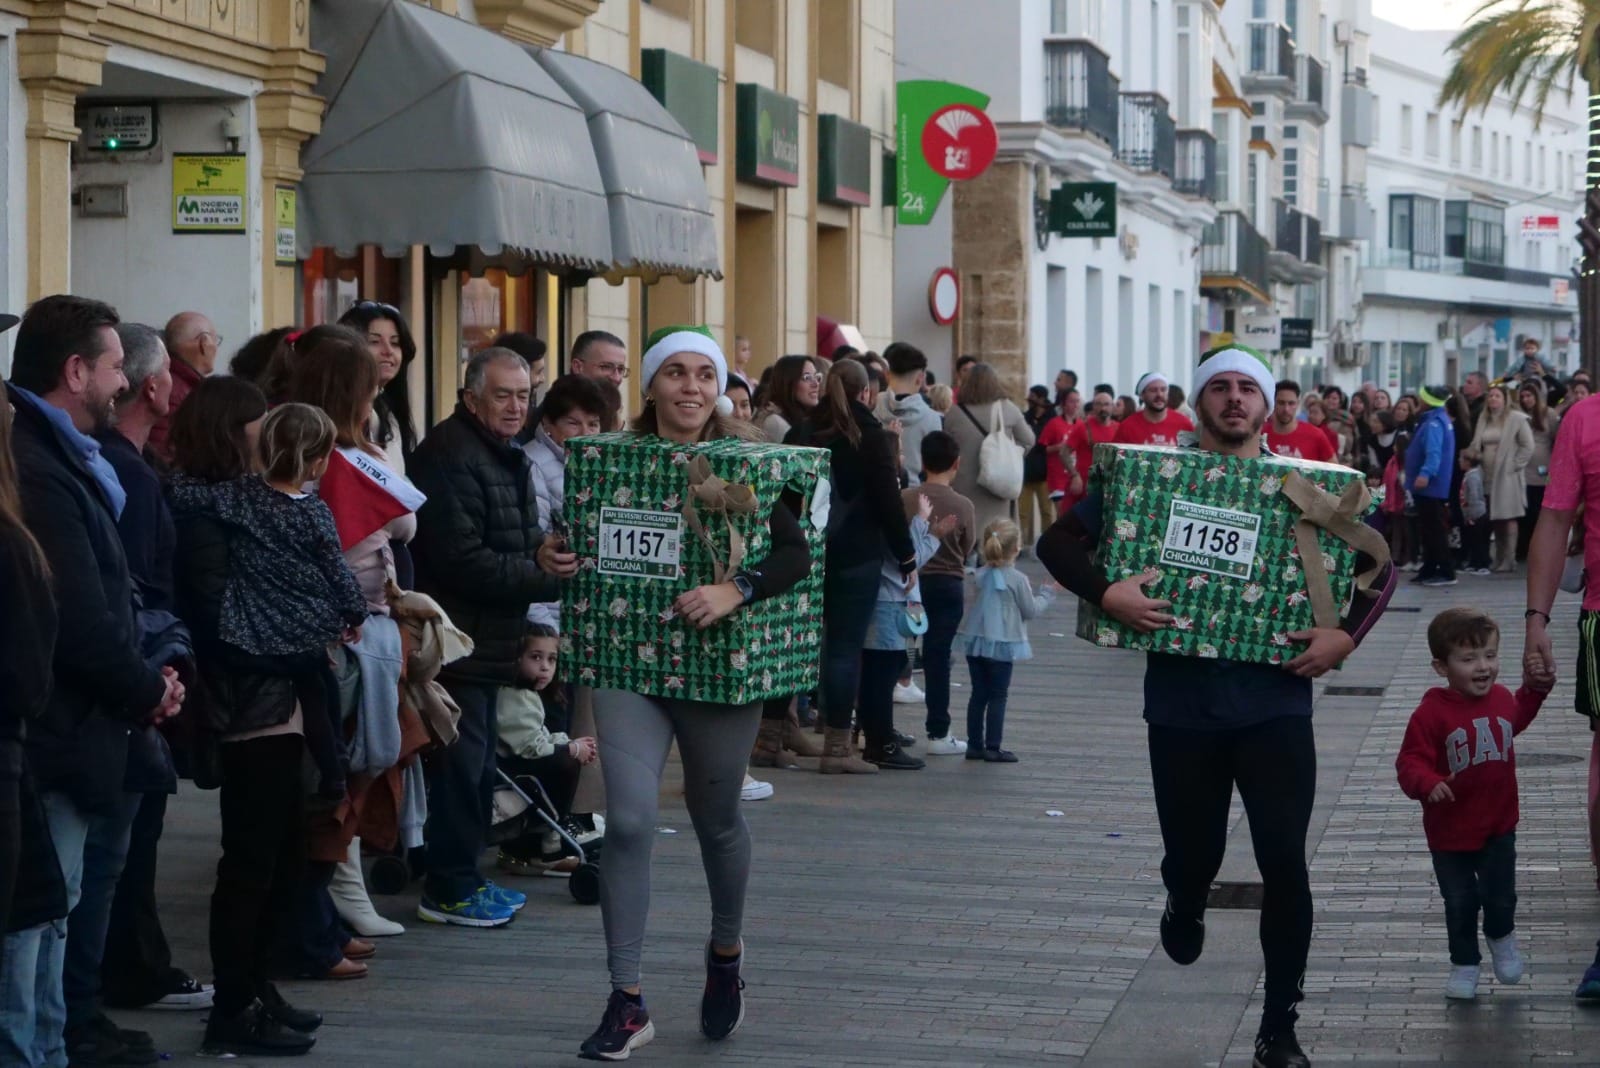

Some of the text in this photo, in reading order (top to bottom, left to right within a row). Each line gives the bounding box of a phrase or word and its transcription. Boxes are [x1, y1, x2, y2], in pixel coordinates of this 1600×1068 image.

[903, 192, 924, 215] 24
[617, 512, 642, 520] SILVESTRE
[643, 514, 677, 523] CHICLANERA
[1175, 503, 1190, 512] SAN
[1190, 505, 1218, 517] SILVESTRE
[1219, 511, 1255, 524] CHICLANERA
[613, 528, 665, 558] 1157
[1183, 522, 1240, 556] 1158
[602, 559, 641, 571] CHICLANA
[1165, 550, 1210, 567] CHICLANA
[1445, 716, 1513, 774] GAP
